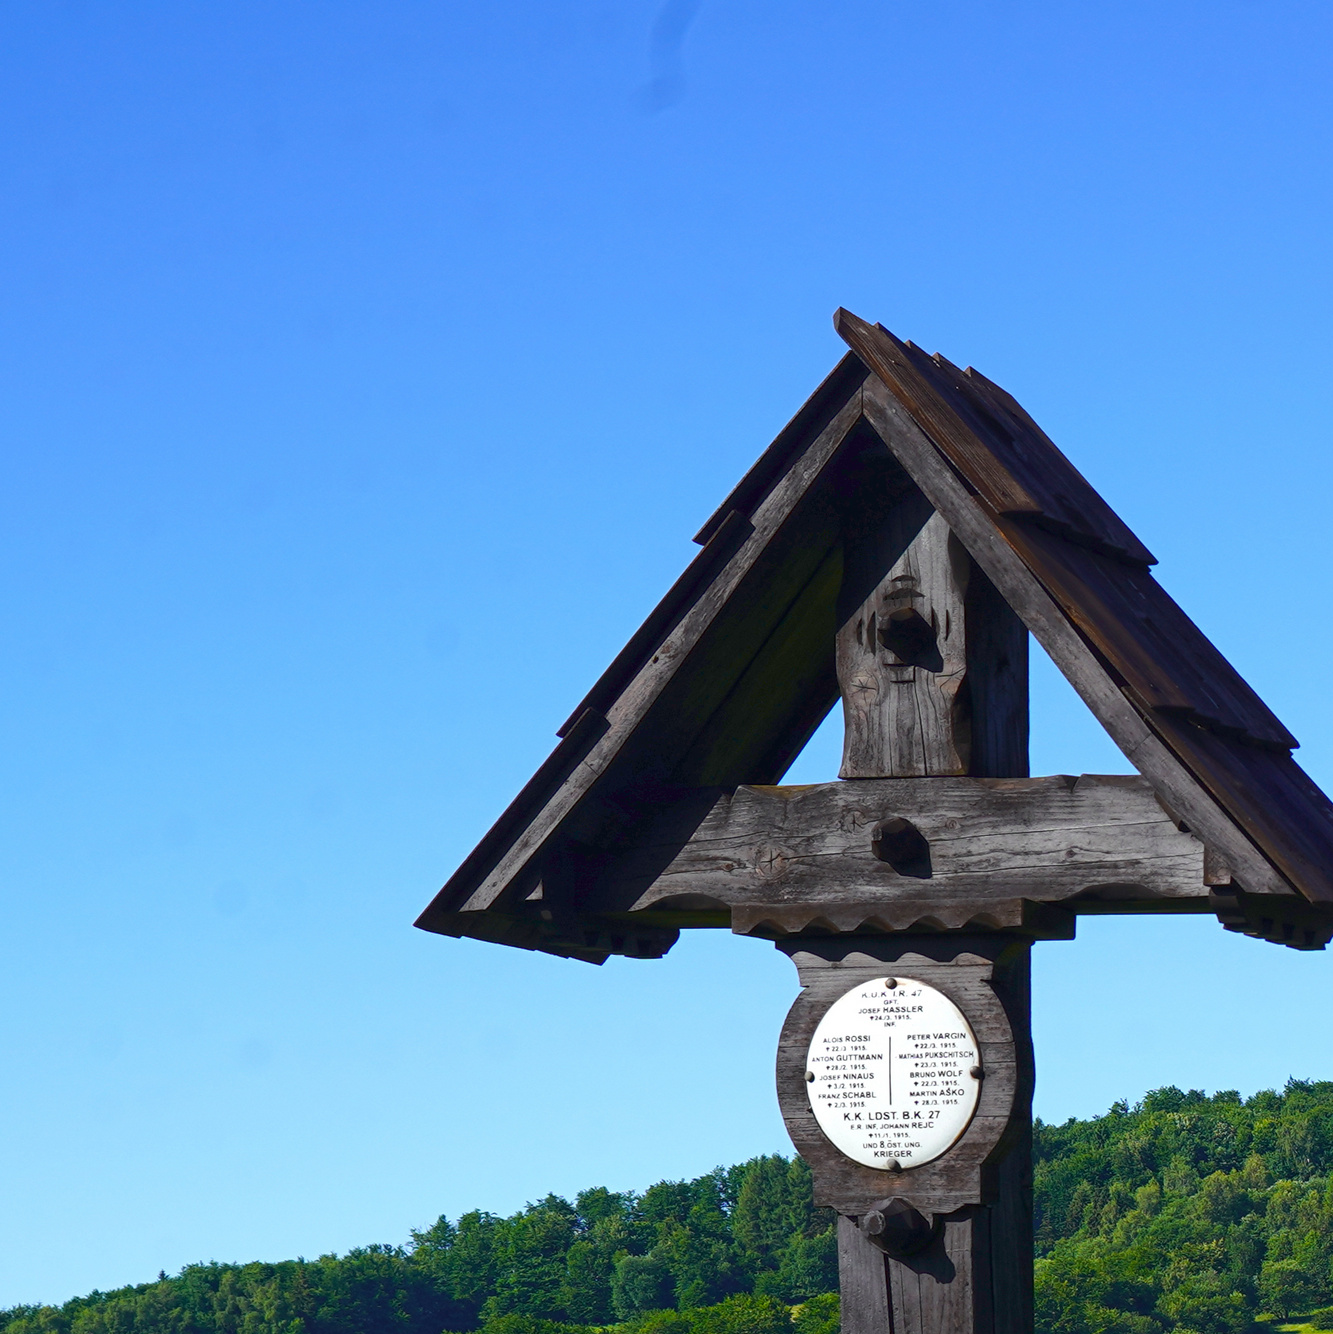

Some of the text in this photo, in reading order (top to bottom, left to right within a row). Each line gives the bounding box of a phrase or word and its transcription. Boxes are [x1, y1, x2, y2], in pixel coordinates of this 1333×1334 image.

[844, 1111, 940, 1121] K.K. LDST. B.K. 27
